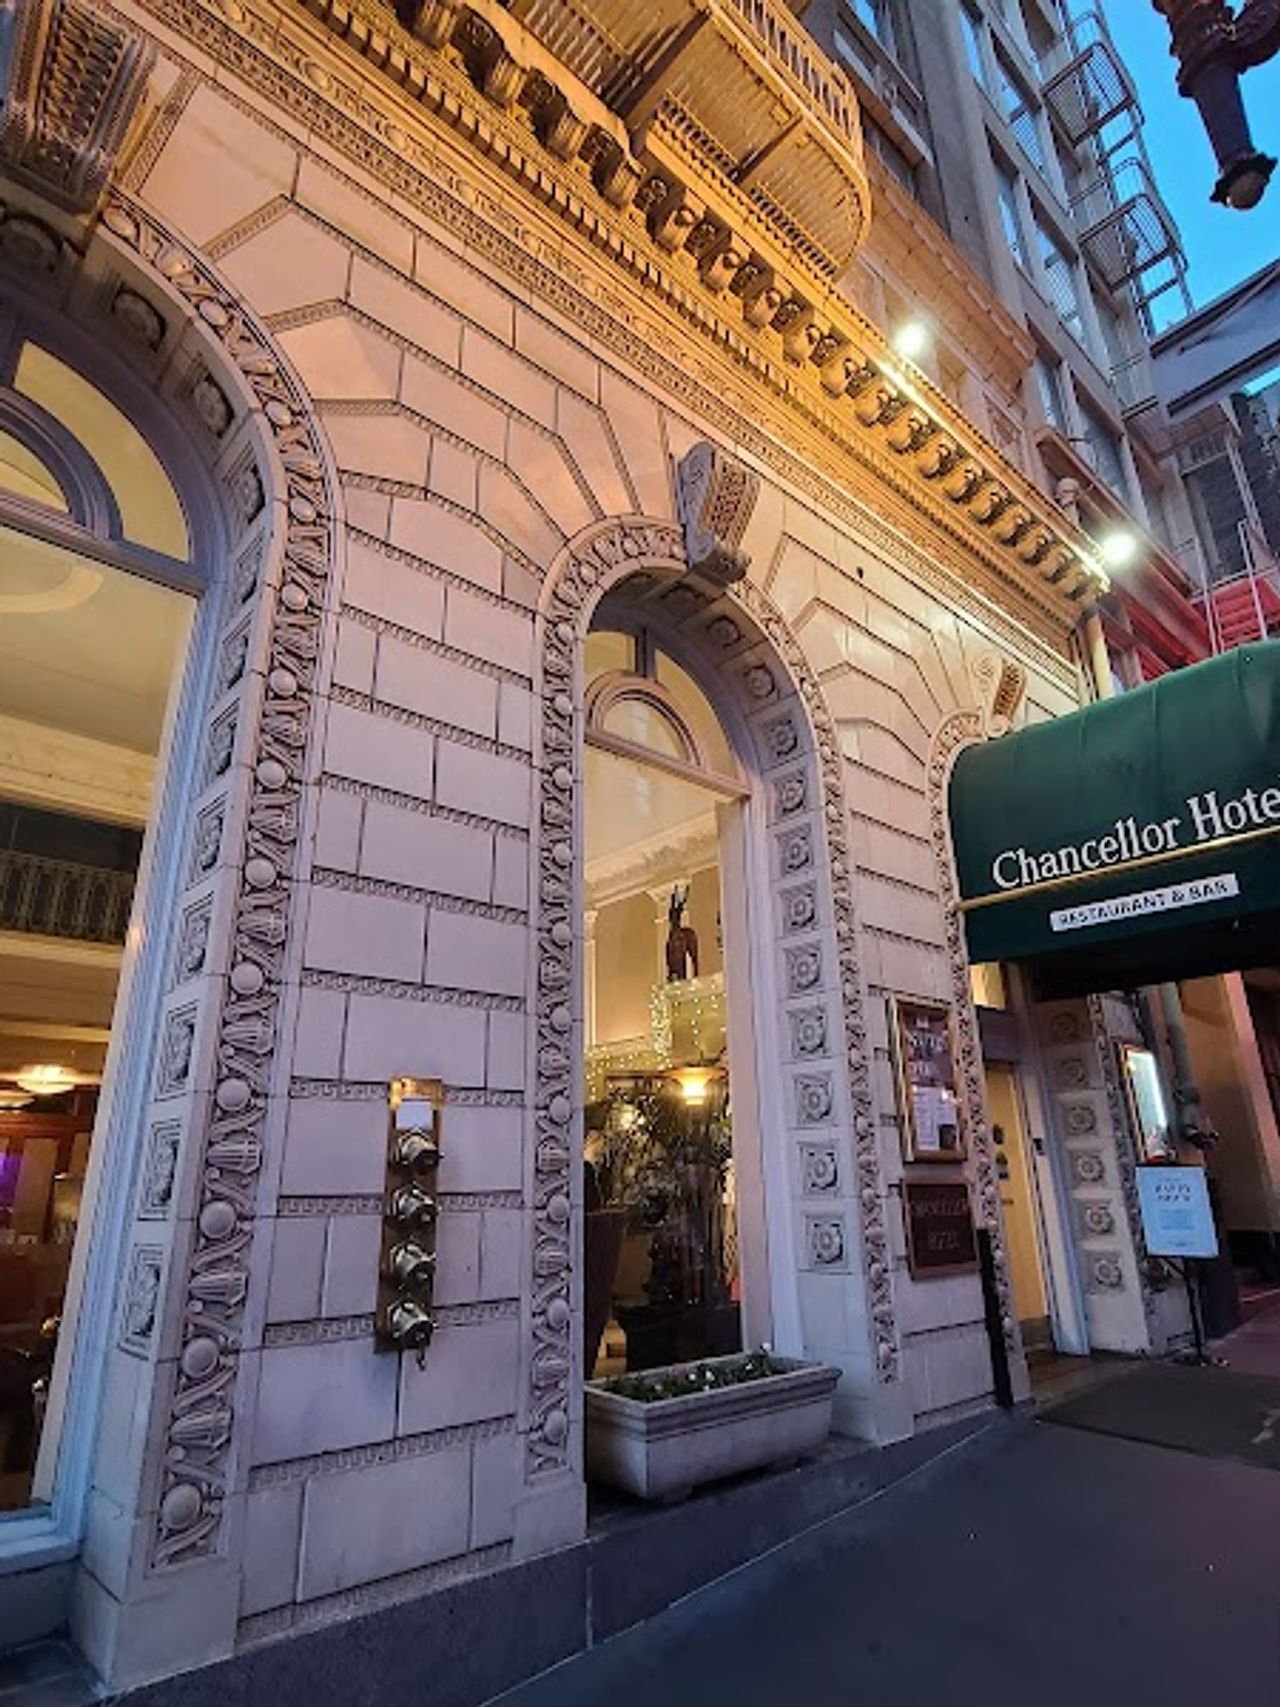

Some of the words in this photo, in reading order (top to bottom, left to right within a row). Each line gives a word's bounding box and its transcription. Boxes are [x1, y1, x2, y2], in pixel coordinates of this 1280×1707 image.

[992, 816, 1182, 889] Chancellor
[1187, 773, 1280, 840] Hote
[1059, 893, 1165, 925] RESTAURANT
[1171, 889, 1185, 903] &
[1189, 880, 1229, 901] BAR
